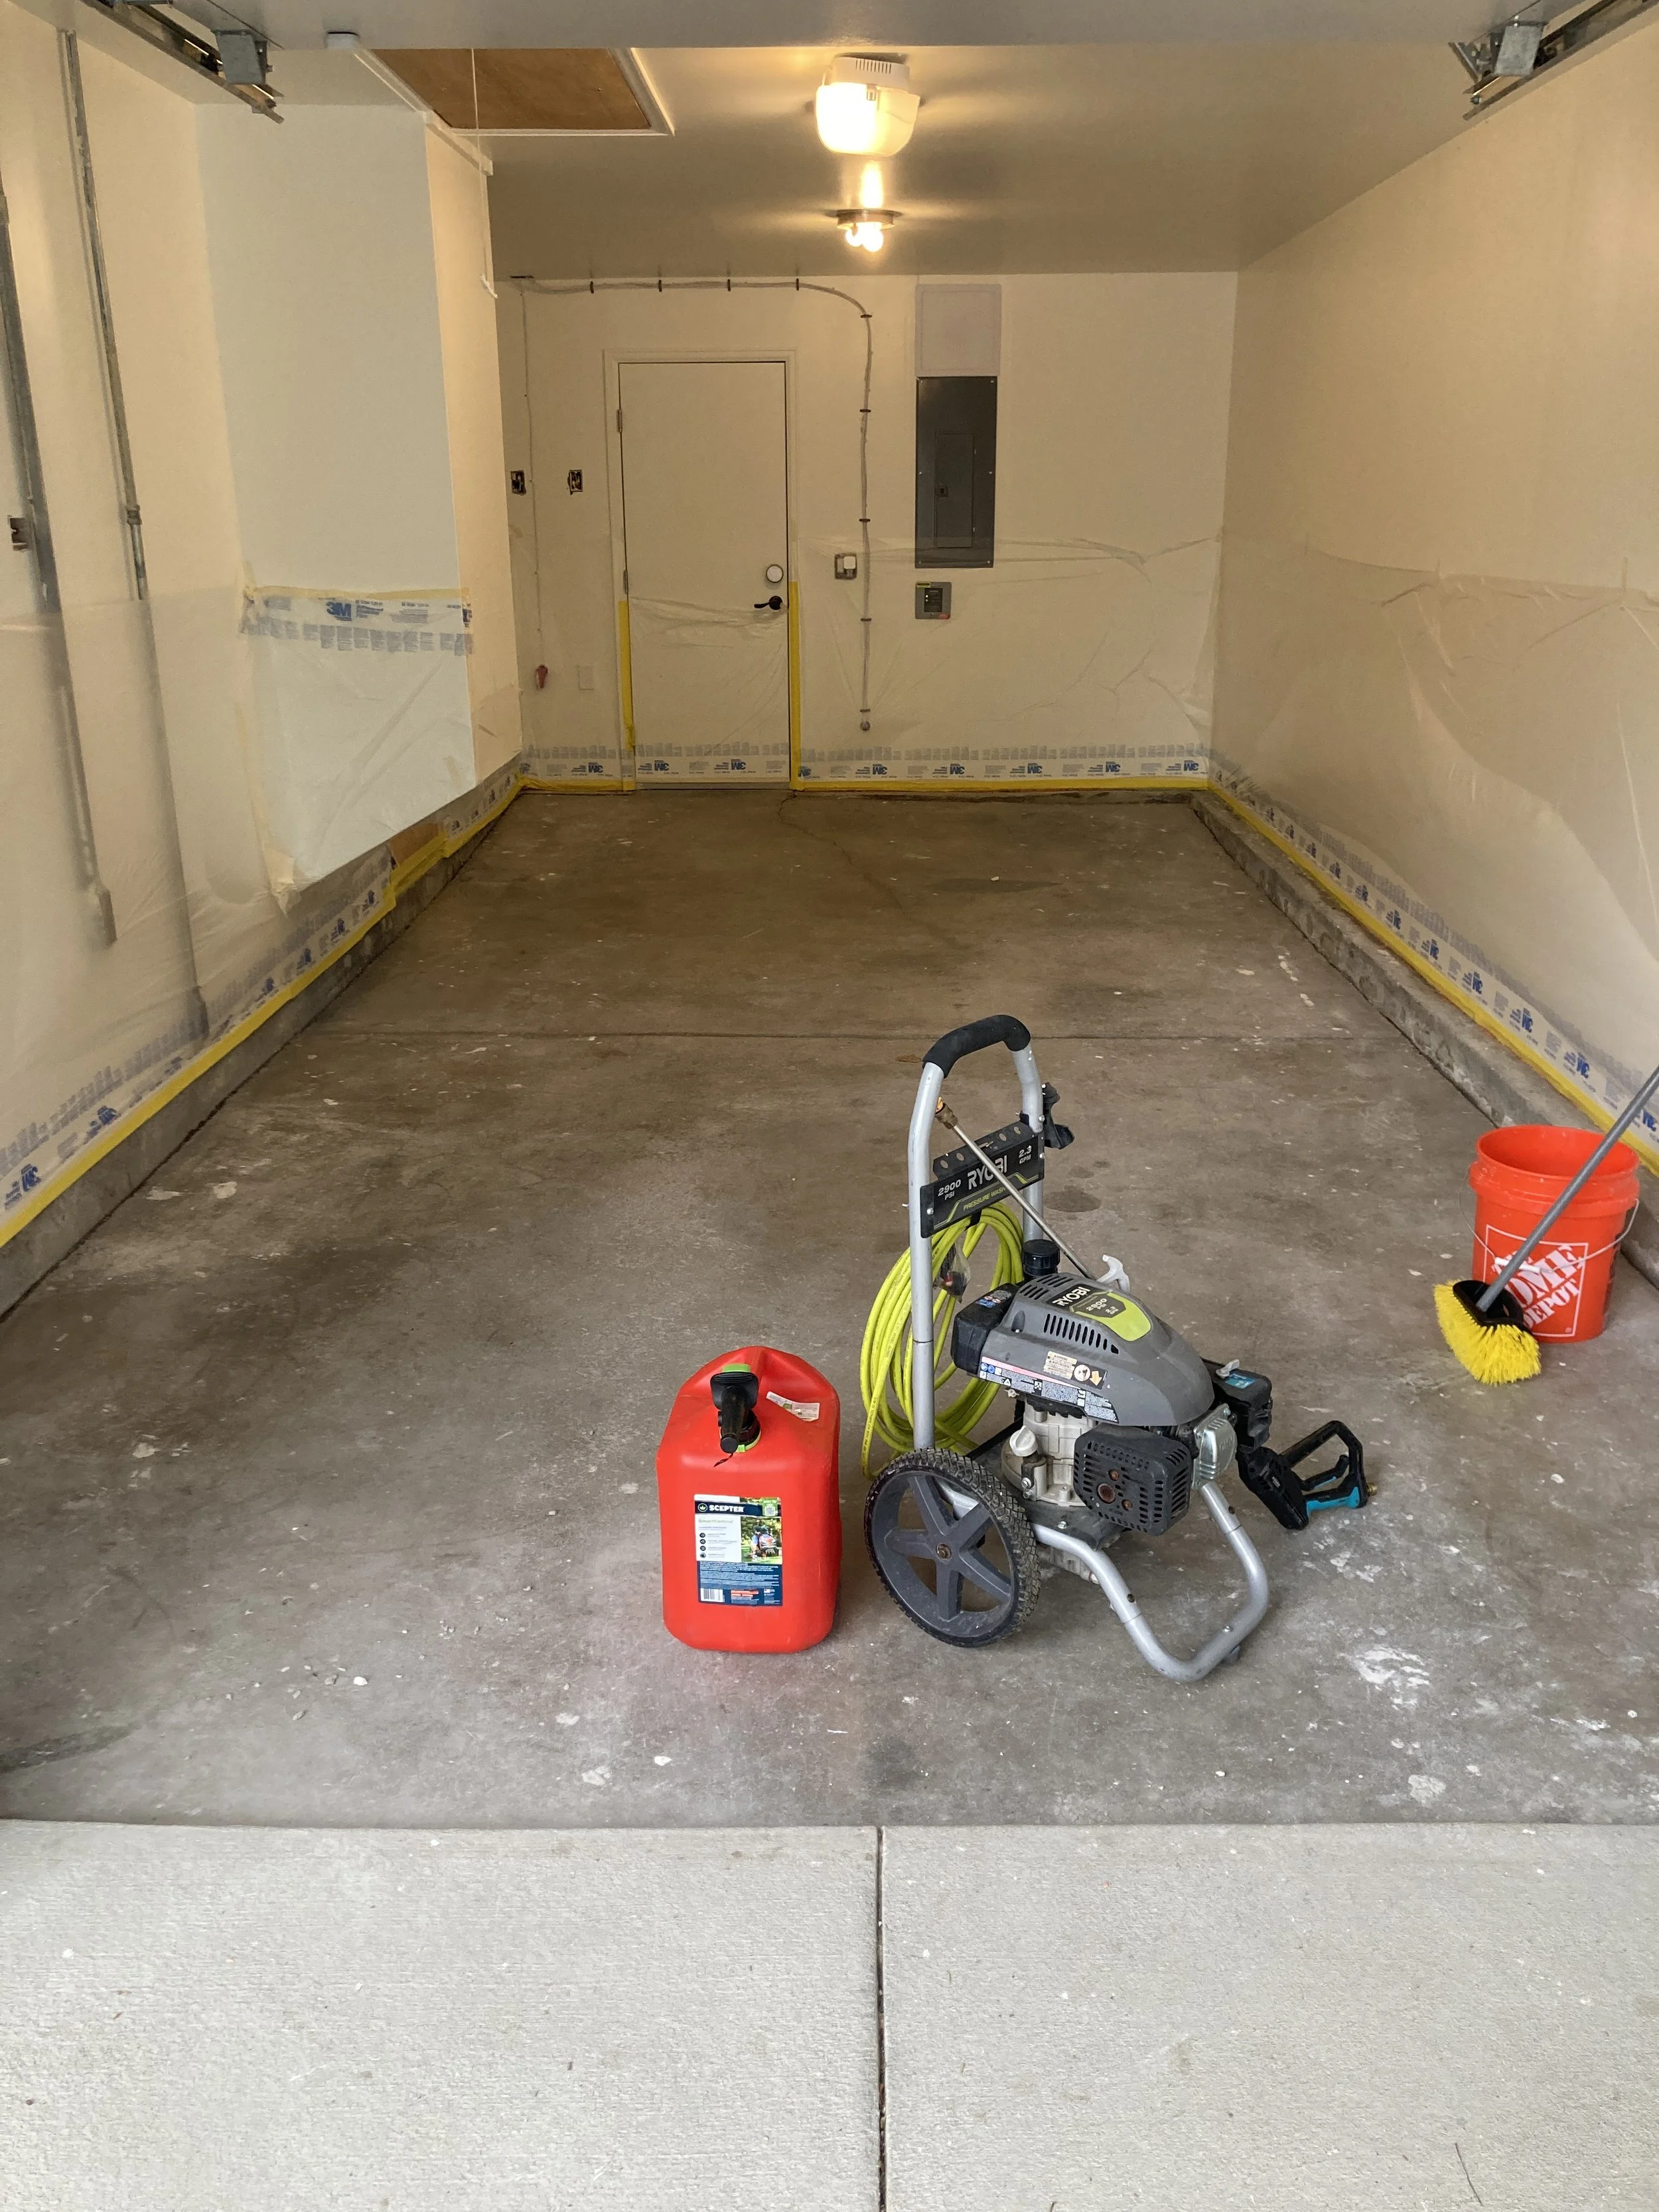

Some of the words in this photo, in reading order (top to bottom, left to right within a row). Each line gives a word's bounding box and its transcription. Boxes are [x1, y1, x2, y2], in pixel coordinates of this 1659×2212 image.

[326, 601, 351, 617] 3M
[1018, 1145, 1032, 1158] 2.3
[1019, 1155, 1031, 1164] GPM
[938, 1179, 961, 1197] 2900
[944, 1191, 955, 1200] PSI
[964, 1193, 991, 1211] PRESSURE
[991, 1186, 1006, 1197] WASH
[1052, 1286, 1091, 1306] RYOBI
